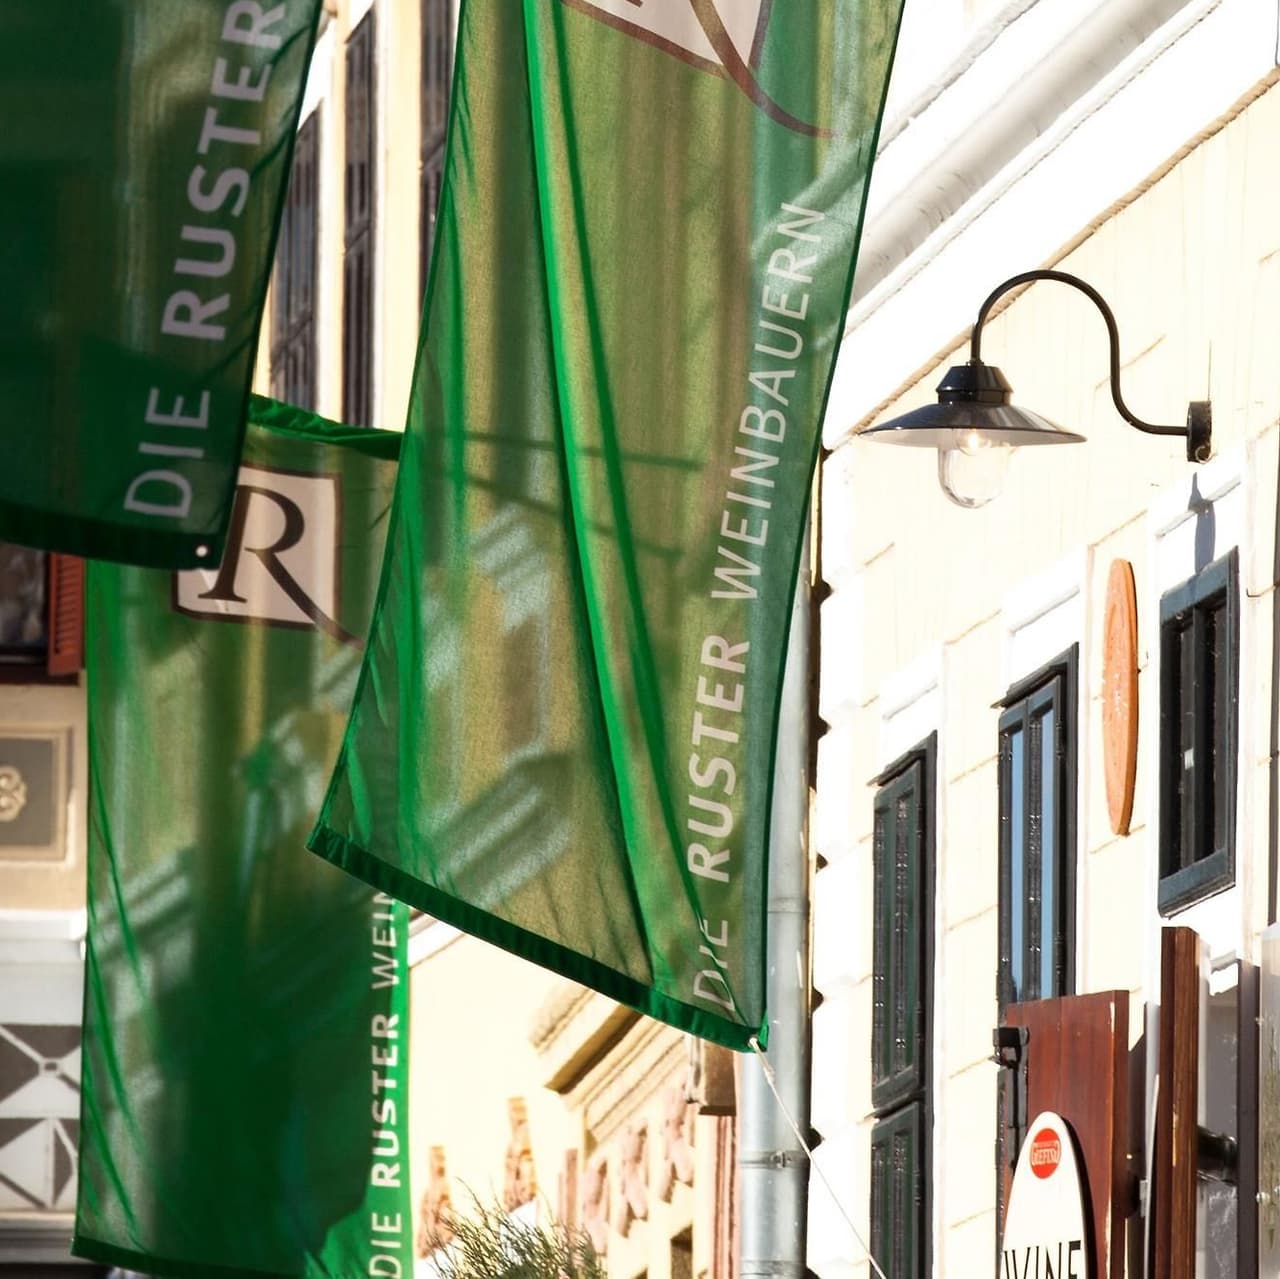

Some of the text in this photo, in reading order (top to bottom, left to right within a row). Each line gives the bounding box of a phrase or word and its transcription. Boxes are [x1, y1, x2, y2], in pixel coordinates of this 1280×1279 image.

[123, 385, 211, 519] DIE
[710, 202, 826, 600] WEINBAUERN
[197, 484, 364, 651] R
[687, 634, 750, 883] RUSTER
[371, 1013, 401, 1188] RUSTER
[369, 1212, 402, 1279] DIE
